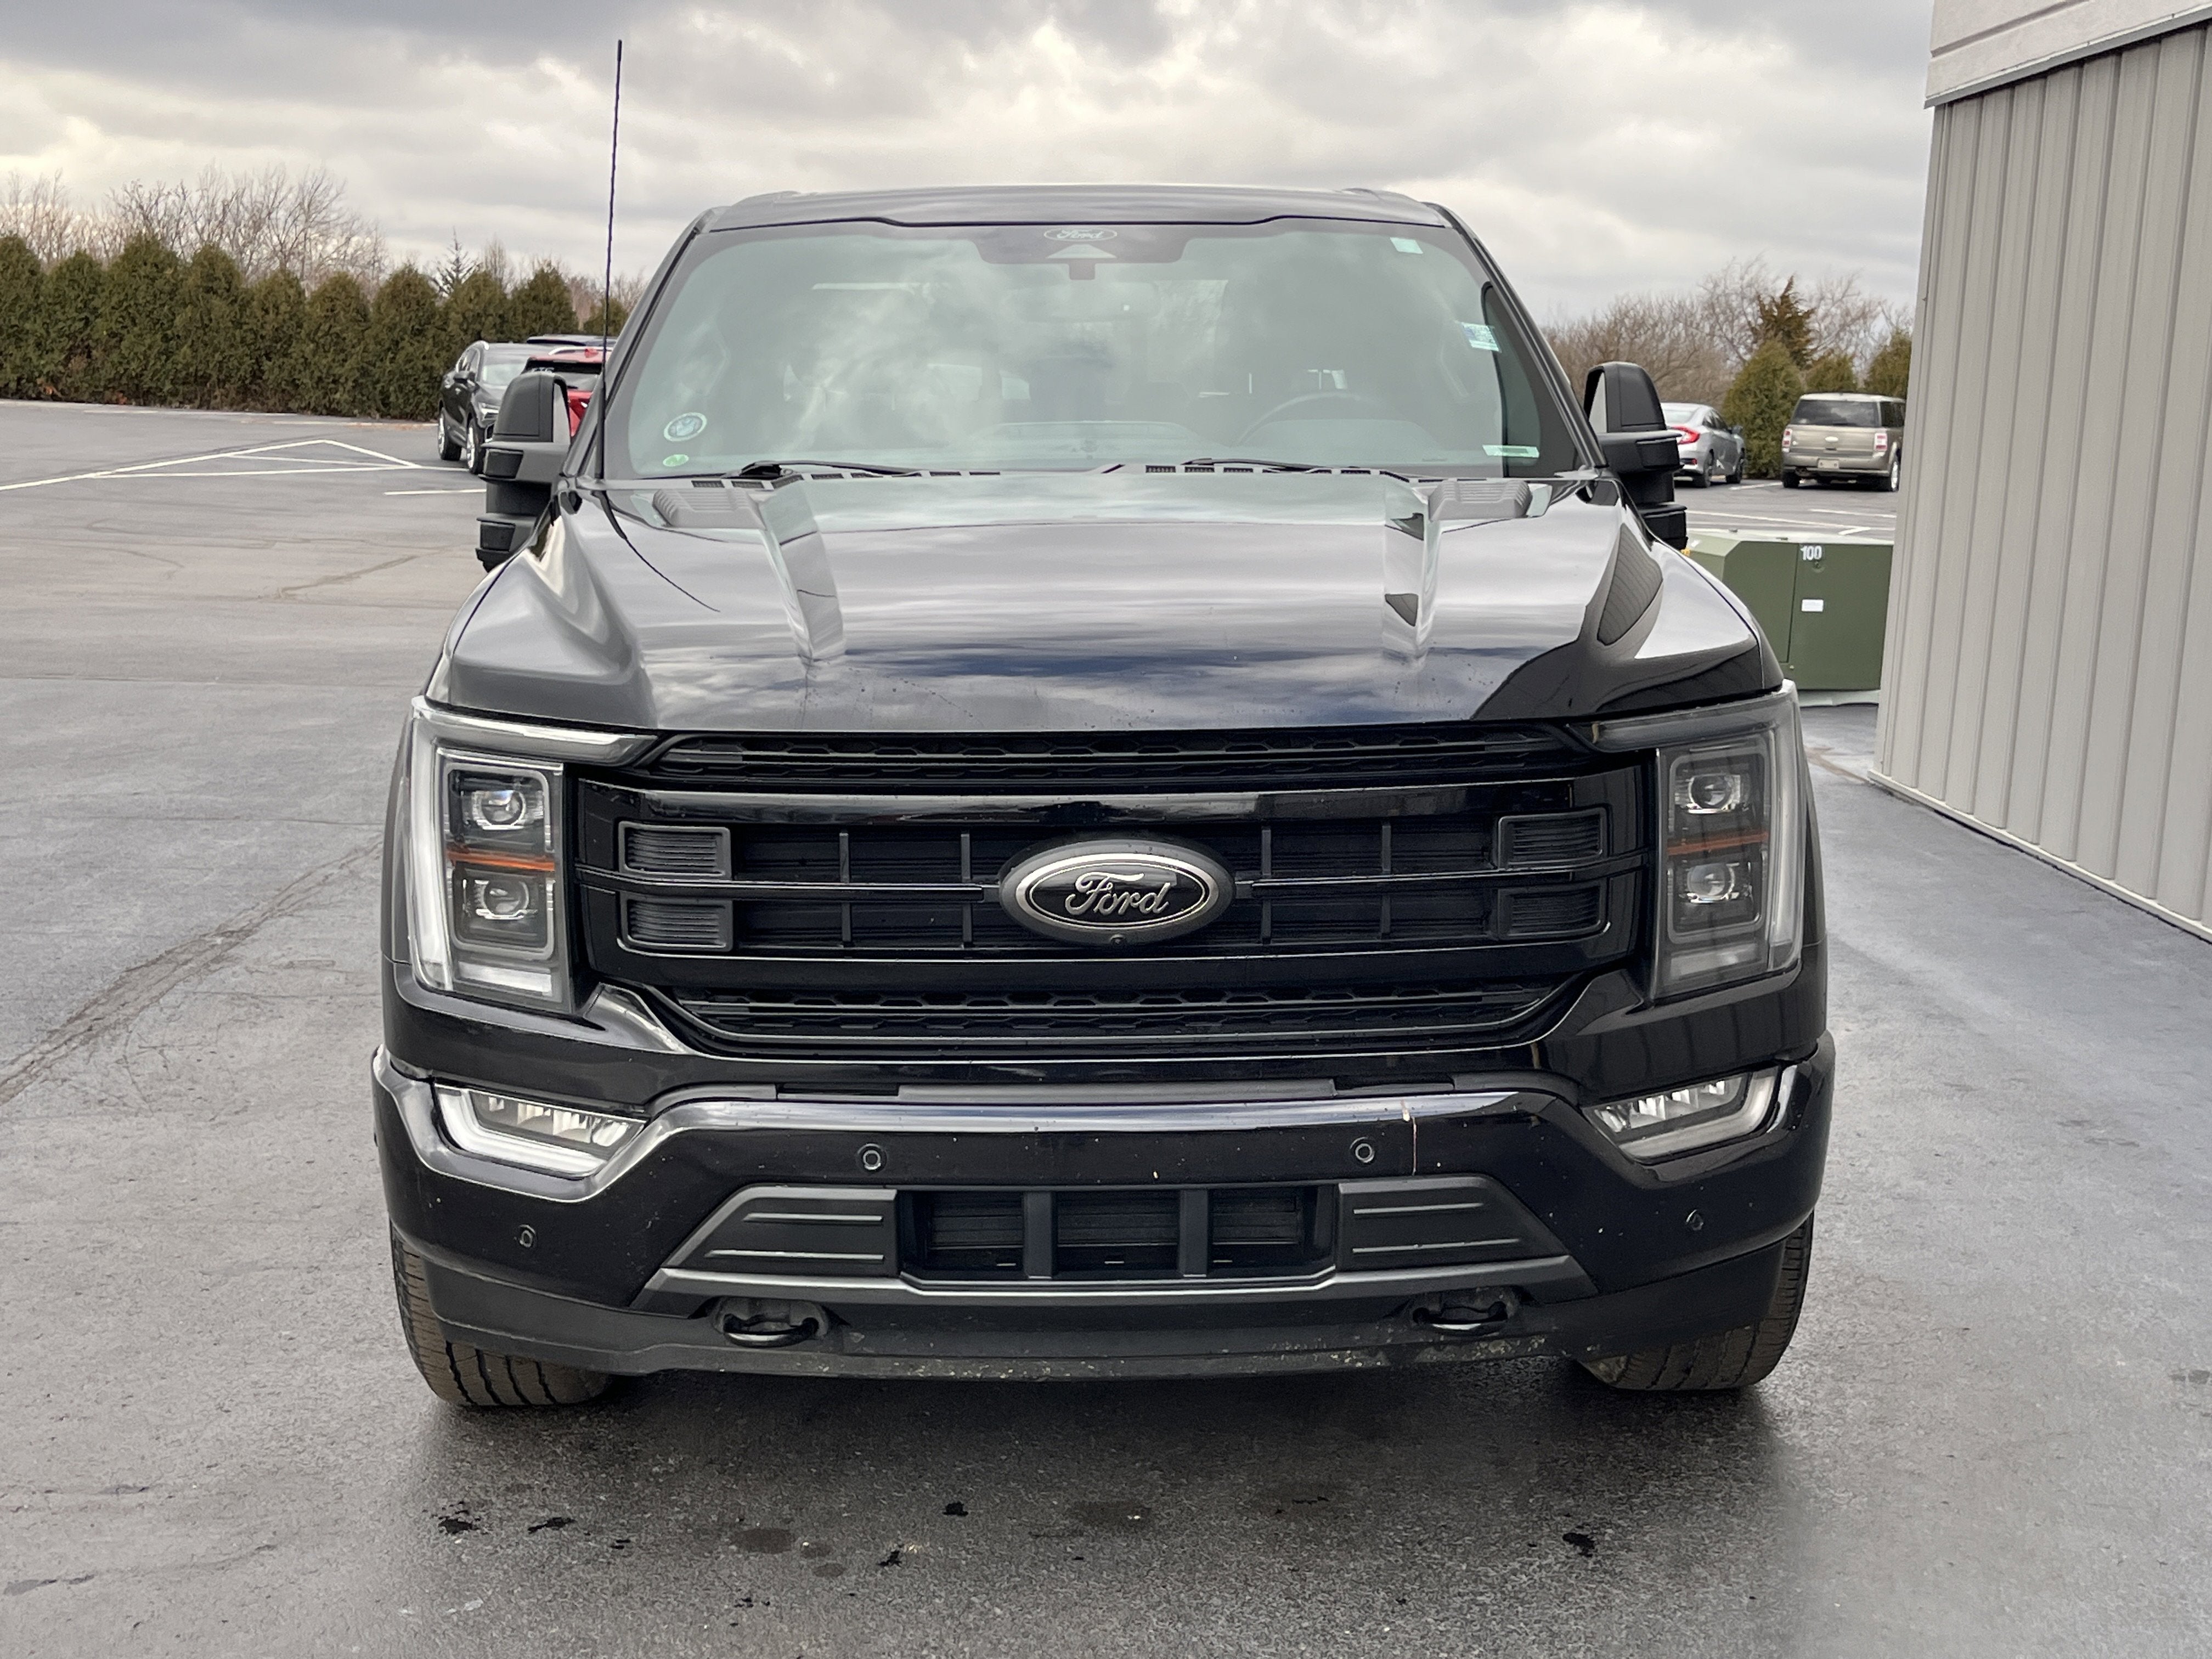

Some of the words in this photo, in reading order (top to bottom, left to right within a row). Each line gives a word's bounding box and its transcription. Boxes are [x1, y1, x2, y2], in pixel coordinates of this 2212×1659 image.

[1057, 228, 1104, 239] Ford
[1800, 545, 1822, 560] 100
[1065, 871, 1171, 916] Ford
